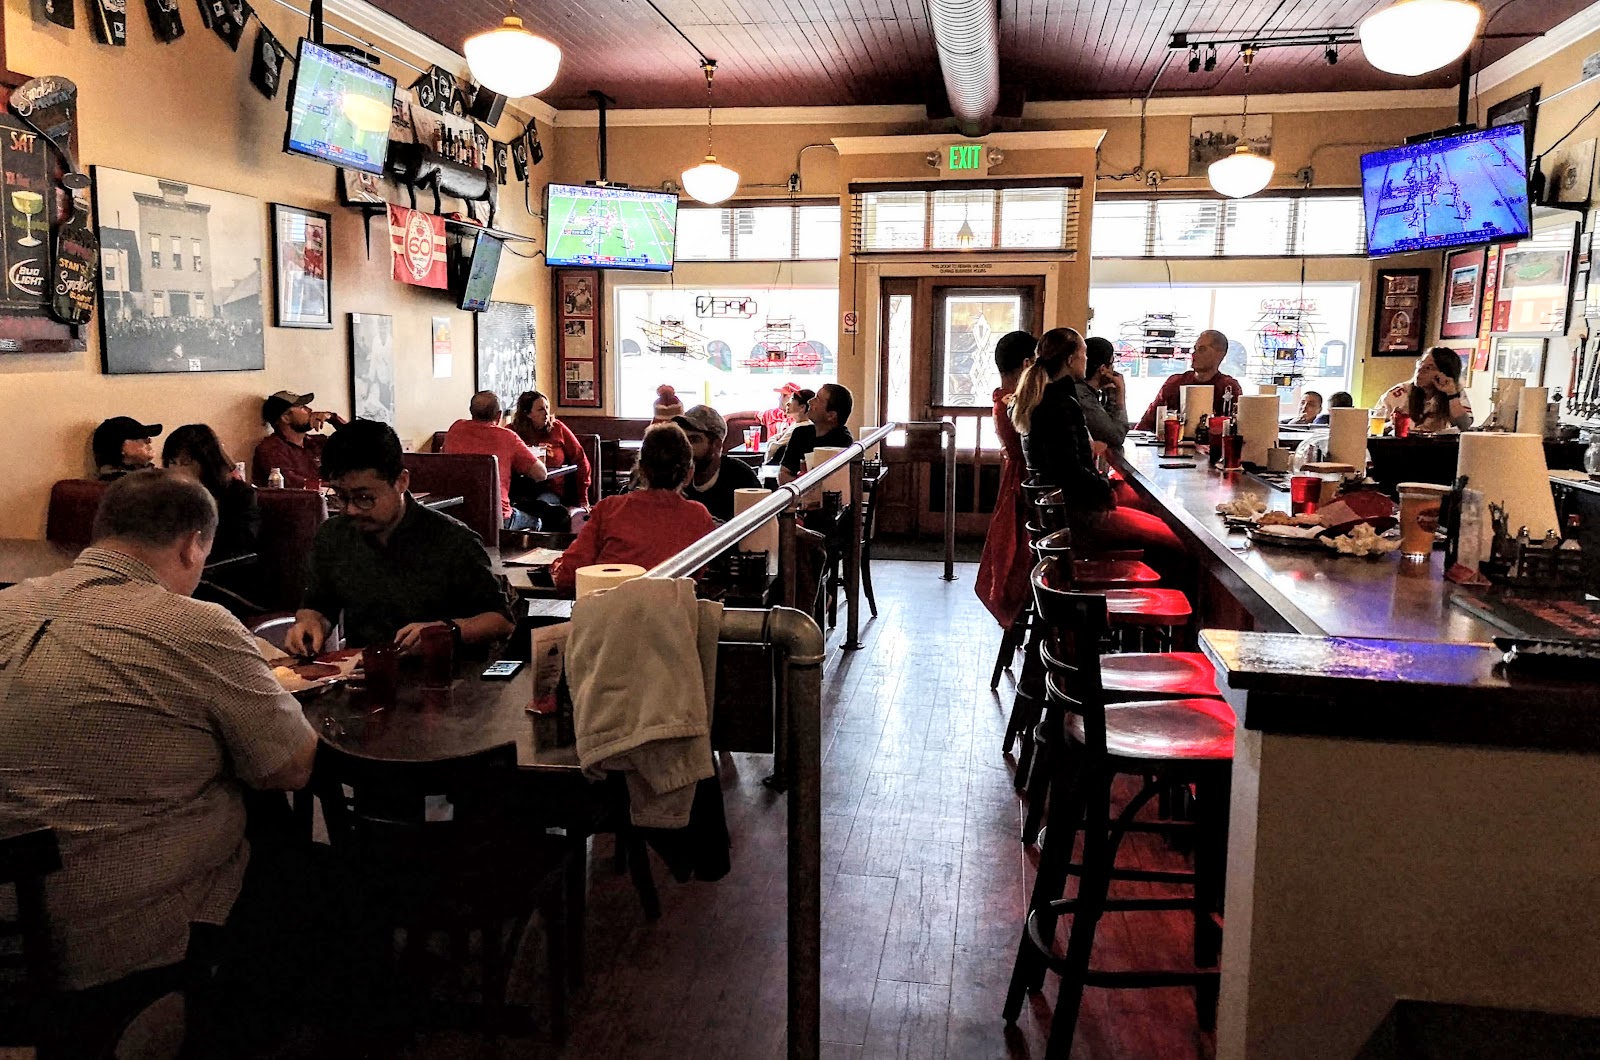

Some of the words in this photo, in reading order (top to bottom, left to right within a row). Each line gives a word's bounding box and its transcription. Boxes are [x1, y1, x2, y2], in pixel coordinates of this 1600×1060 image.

[10, 131, 37, 153] SAT
[949, 145, 982, 169] EXIT
[409, 236, 431, 256] 60
[15, 275, 44, 286] LIGHT
[19, 266, 40, 276] BUD
